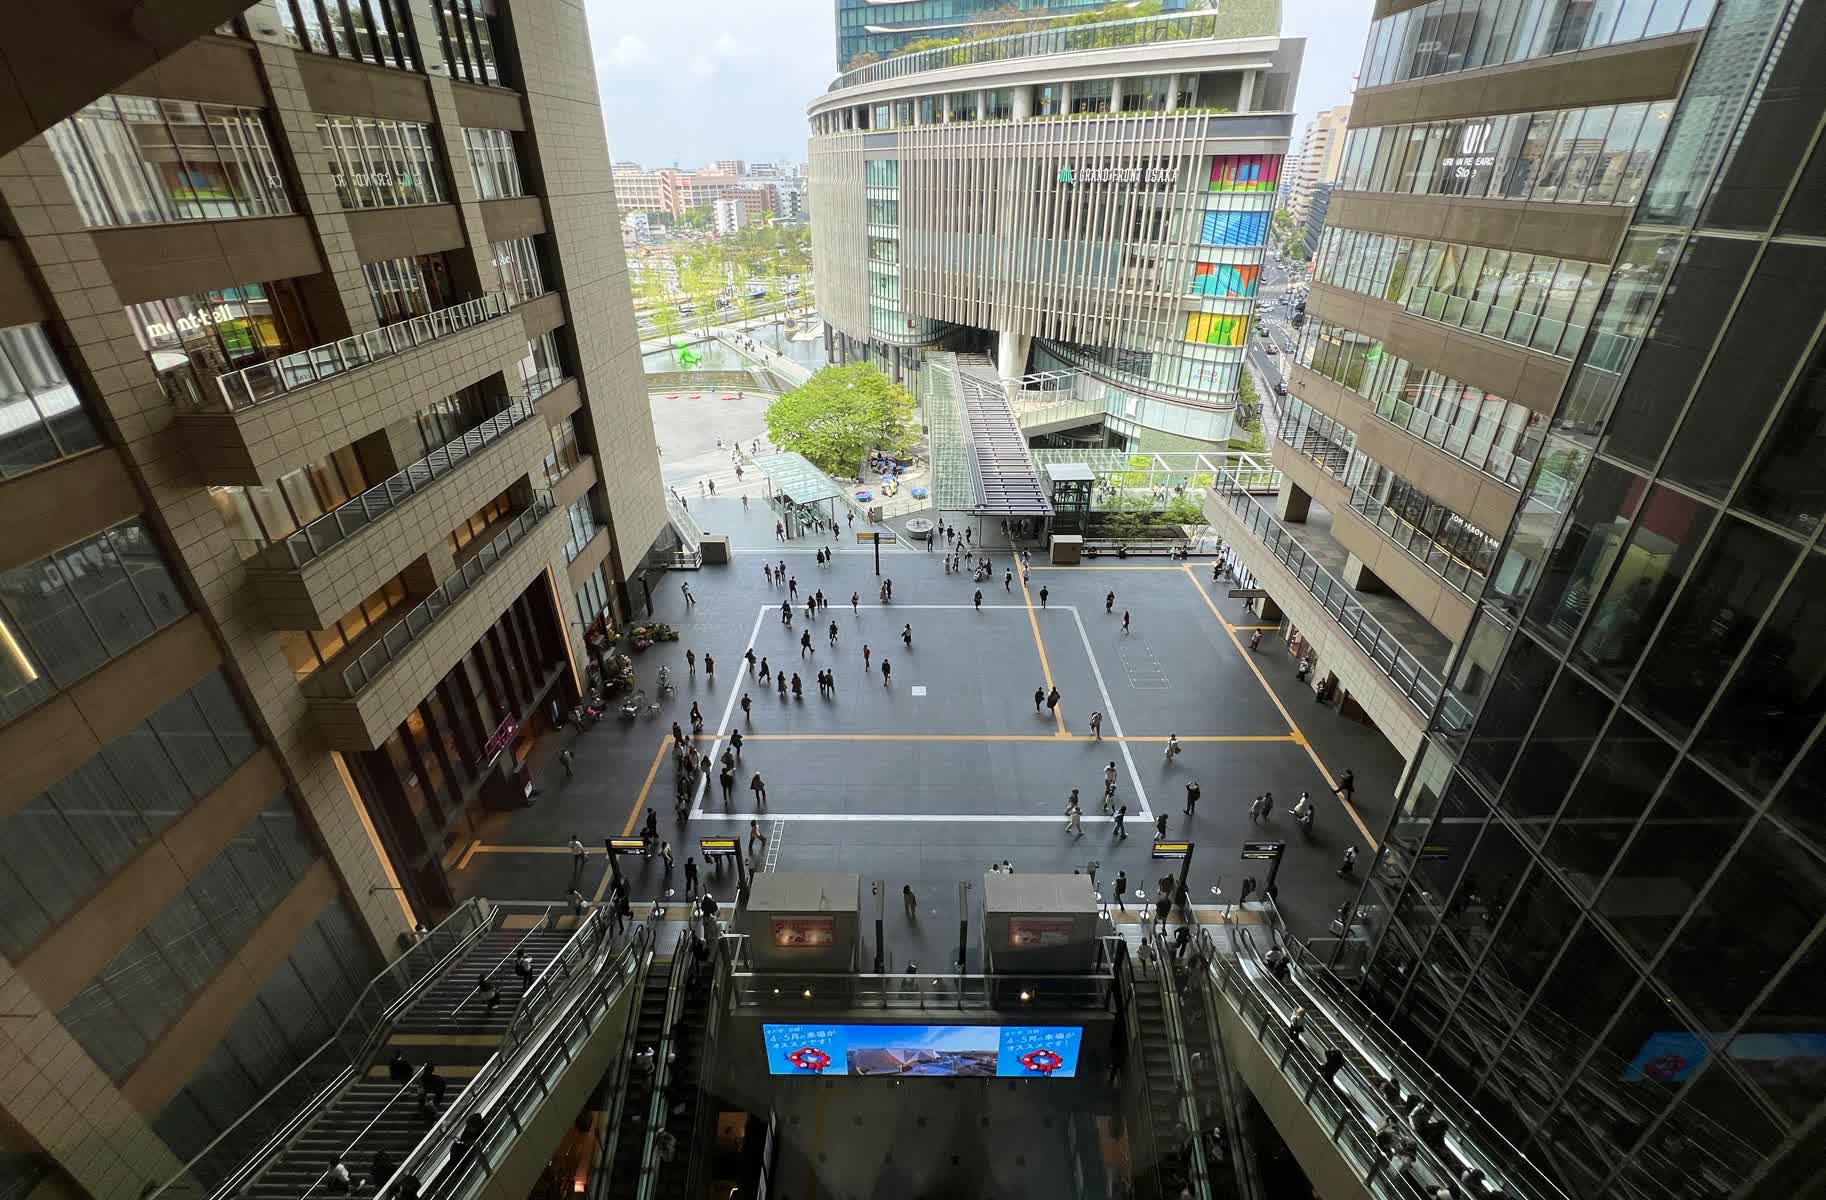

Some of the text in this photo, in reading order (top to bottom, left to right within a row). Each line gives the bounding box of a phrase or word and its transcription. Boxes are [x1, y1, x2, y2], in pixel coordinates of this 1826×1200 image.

[1079, 167, 1109, 183] GRAND
[1144, 167, 1178, 183] OSAKA
[1455, 166, 1478, 178] Stoe
